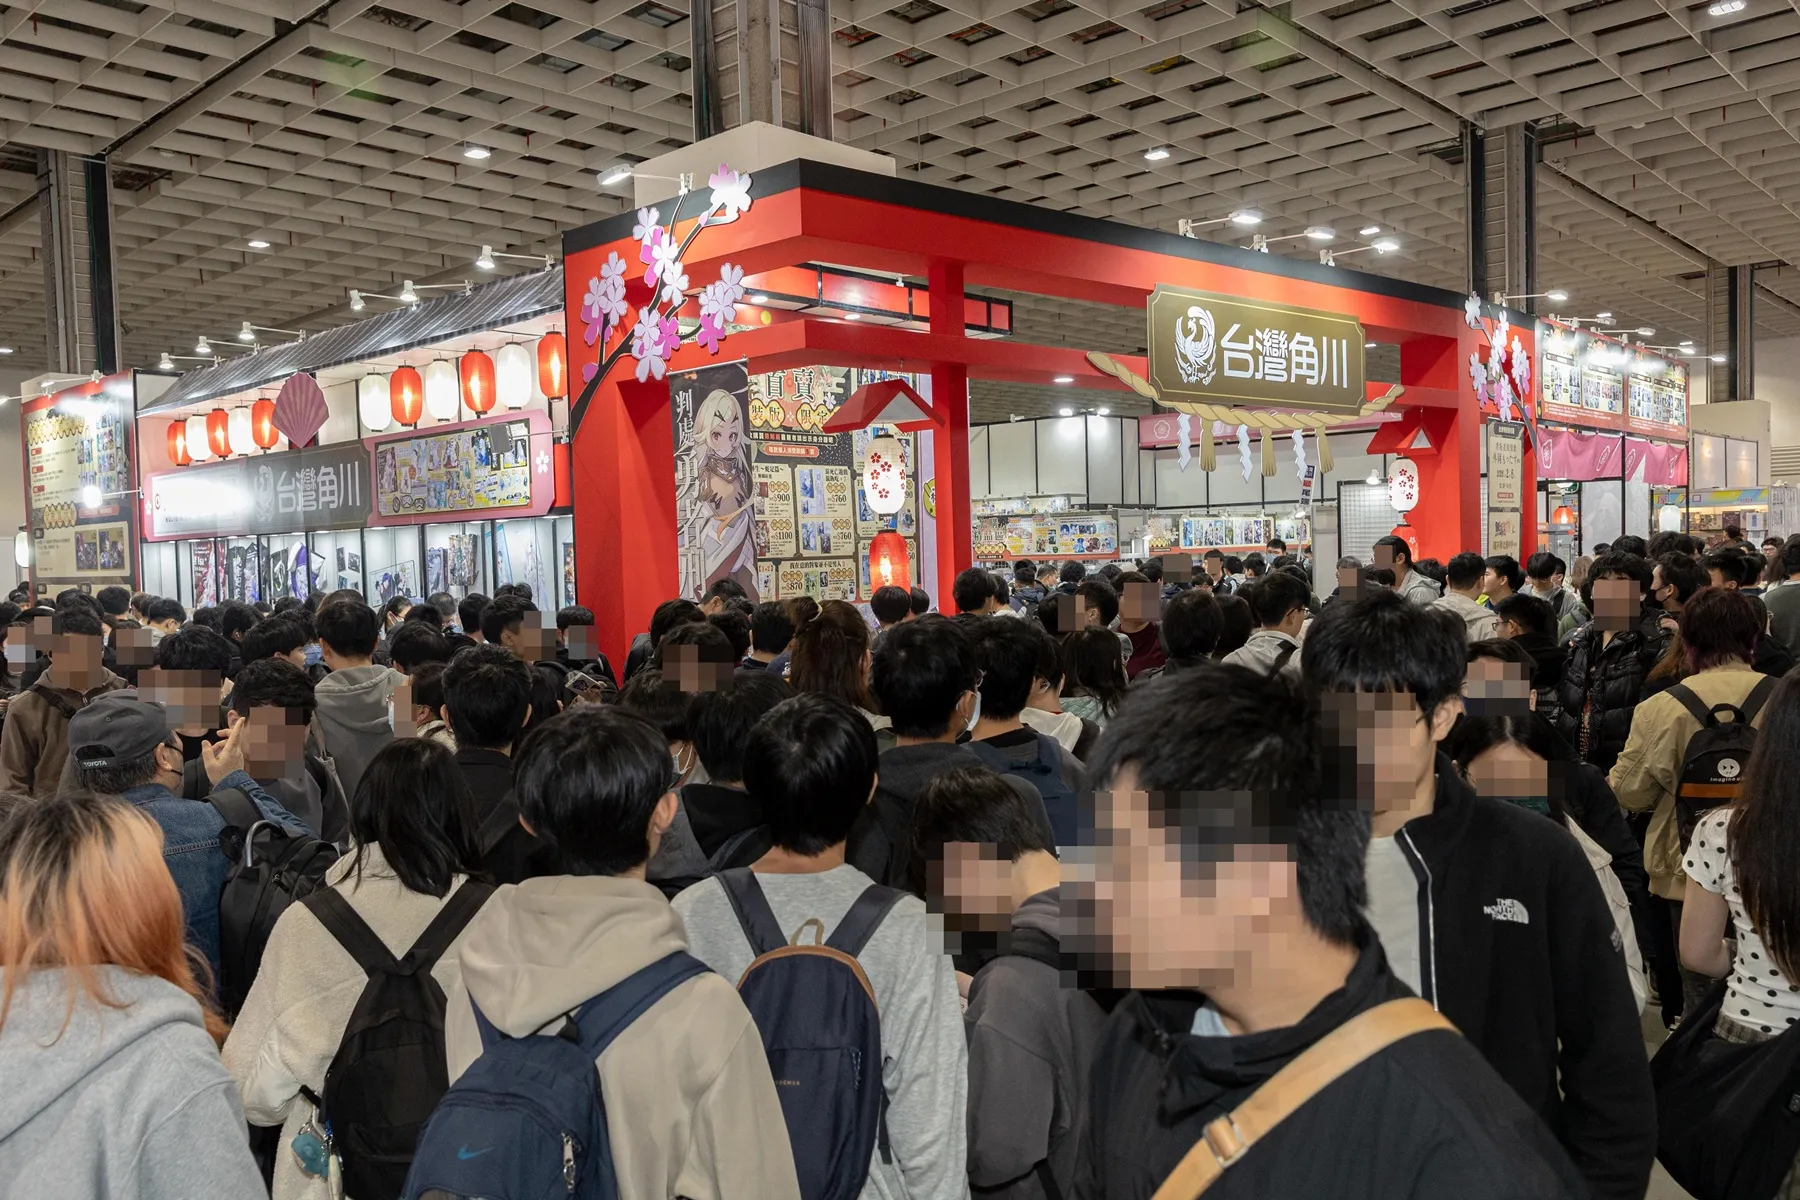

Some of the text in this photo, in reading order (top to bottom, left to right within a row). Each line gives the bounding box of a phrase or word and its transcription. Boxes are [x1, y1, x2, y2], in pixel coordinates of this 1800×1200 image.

[1220, 323, 1348, 389] 台灣角川
[277, 461, 360, 514] 台灣角川
[1496, 898, 1514, 907] THE
[1483, 905, 1514, 914] NORTH
[1492, 912, 1514, 921] FACE
